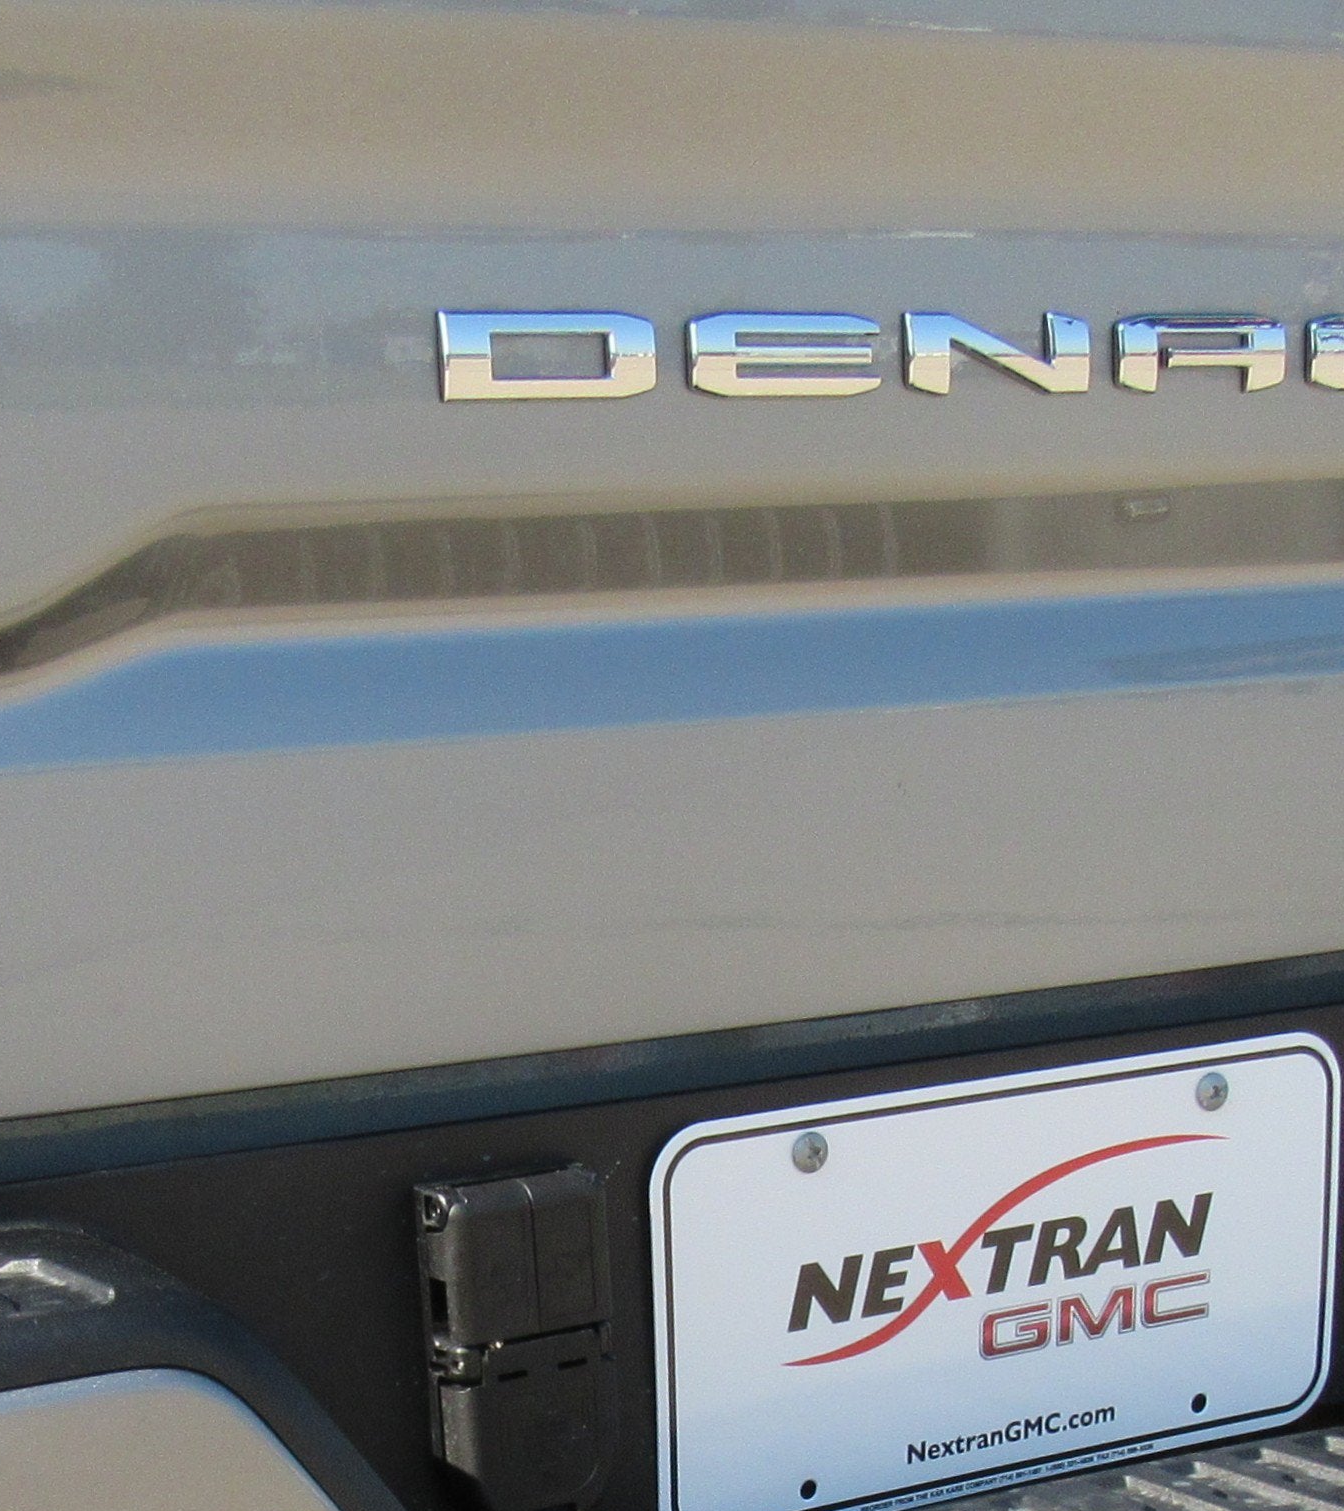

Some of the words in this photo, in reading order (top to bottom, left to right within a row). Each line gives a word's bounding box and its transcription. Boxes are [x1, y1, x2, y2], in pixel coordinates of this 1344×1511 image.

[787, 1192, 1213, 1333] NEXTRAN
[978, 1269, 1211, 1360] GMC
[907, 1406, 1116, 1465] NextranGMC.com
